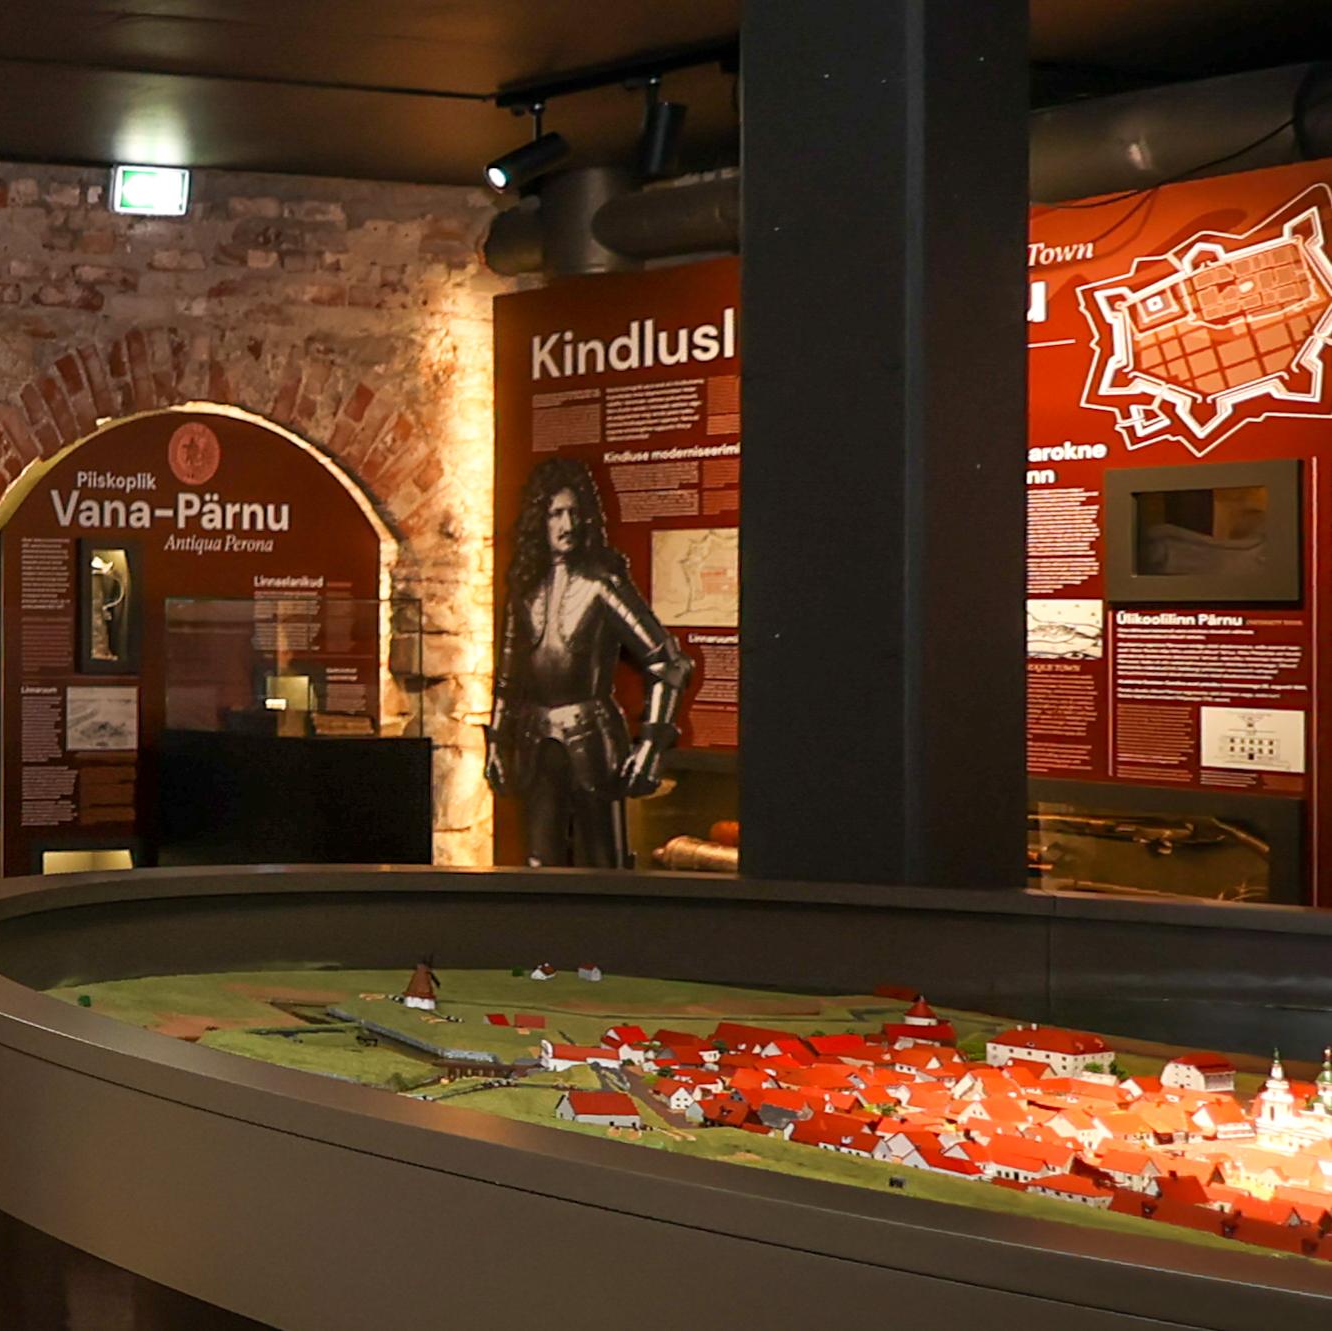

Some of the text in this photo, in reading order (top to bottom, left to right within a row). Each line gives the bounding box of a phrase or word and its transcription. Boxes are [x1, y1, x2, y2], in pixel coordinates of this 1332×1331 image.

[1027, 242, 1094, 267] Town
[532, 307, 735, 381] Kindlusl
[1028, 441, 1108, 462] arokne
[77, 472, 156, 492] Piiskoplik
[50, 489, 290, 532] Vana-Pärnu
[164, 533, 274, 555] Antiqua Perona
[1116, 610, 1196, 625] Ülikoolilinn
[1198, 613, 1243, 626] Pärnu
